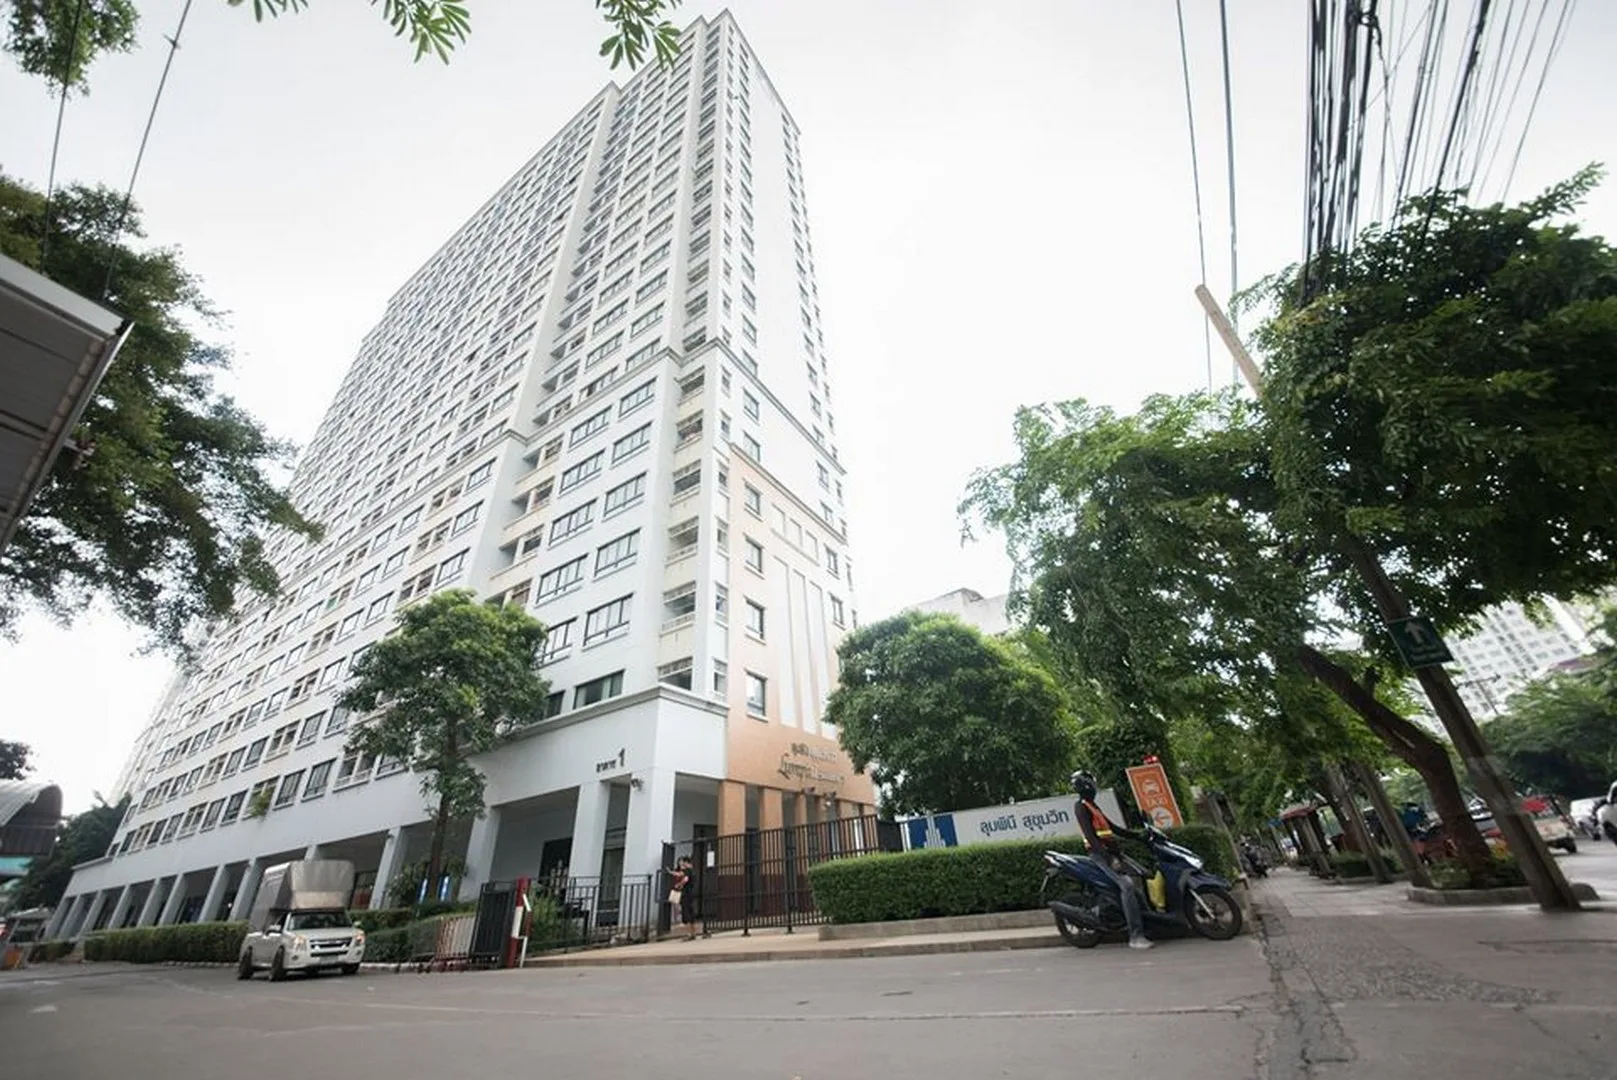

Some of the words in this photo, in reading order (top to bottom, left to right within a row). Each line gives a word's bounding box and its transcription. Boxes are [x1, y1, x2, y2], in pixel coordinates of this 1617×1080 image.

[981, 814, 1017, 836] ลุมพินี
[1022, 809, 1070, 831] สุขุมวิท
